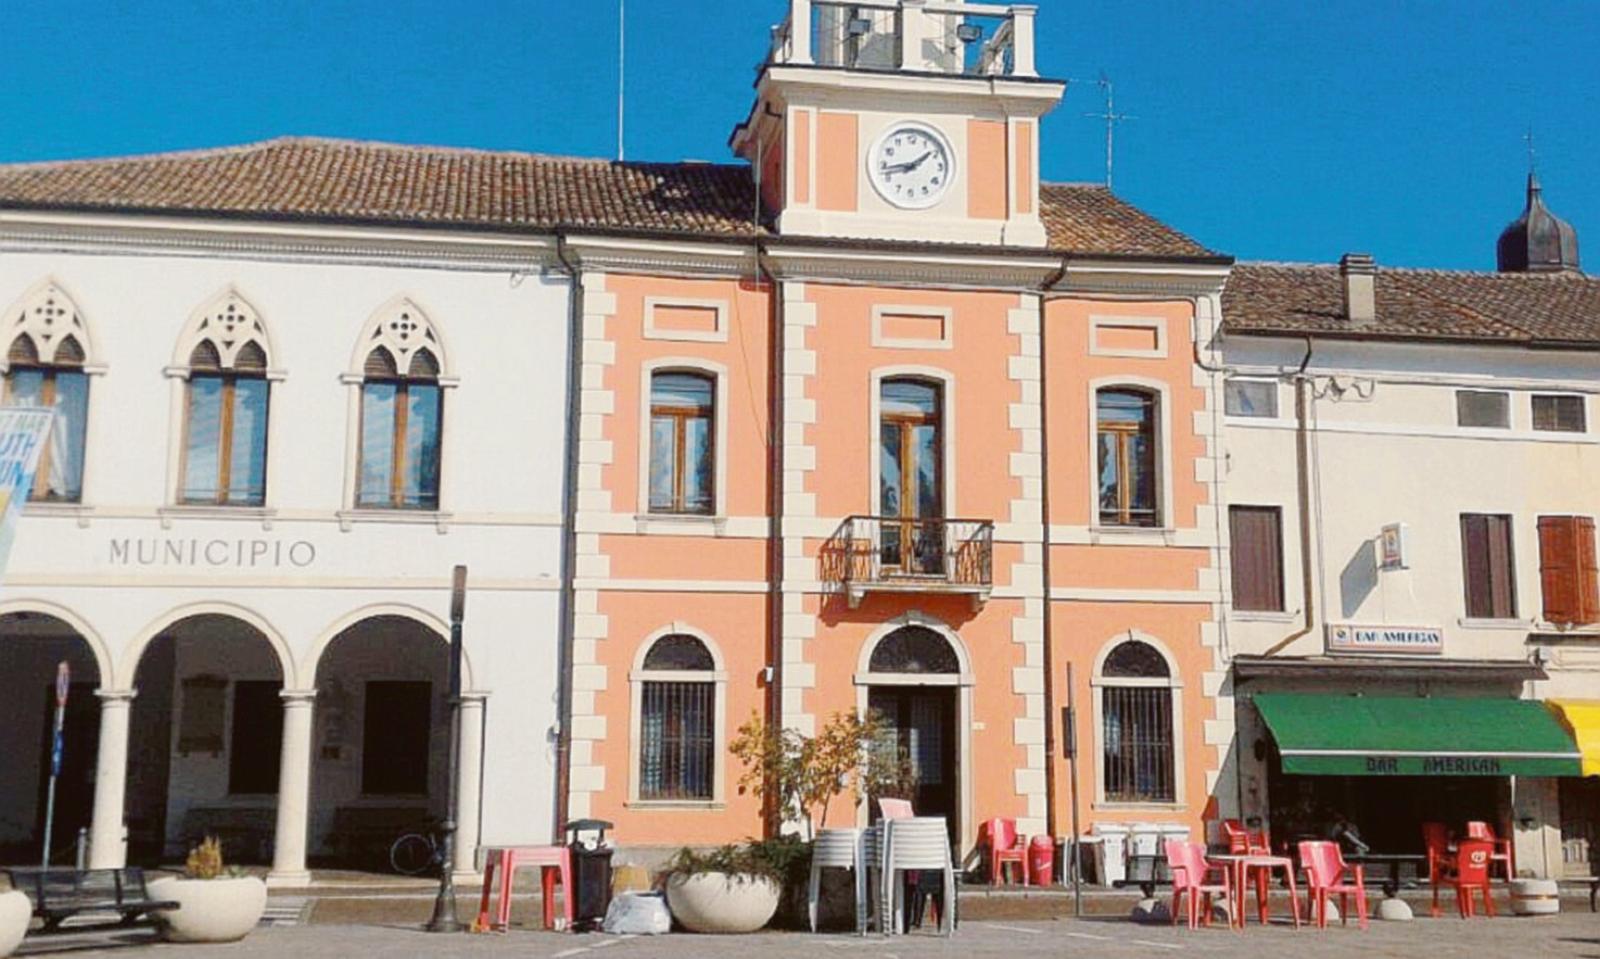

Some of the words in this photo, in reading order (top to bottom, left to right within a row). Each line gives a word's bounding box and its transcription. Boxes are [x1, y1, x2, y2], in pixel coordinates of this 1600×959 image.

[109, 538, 316, 567] MUNICIPIO
[1366, 756, 1399, 773] BAR
[1423, 756, 1501, 773] AMERICAN
